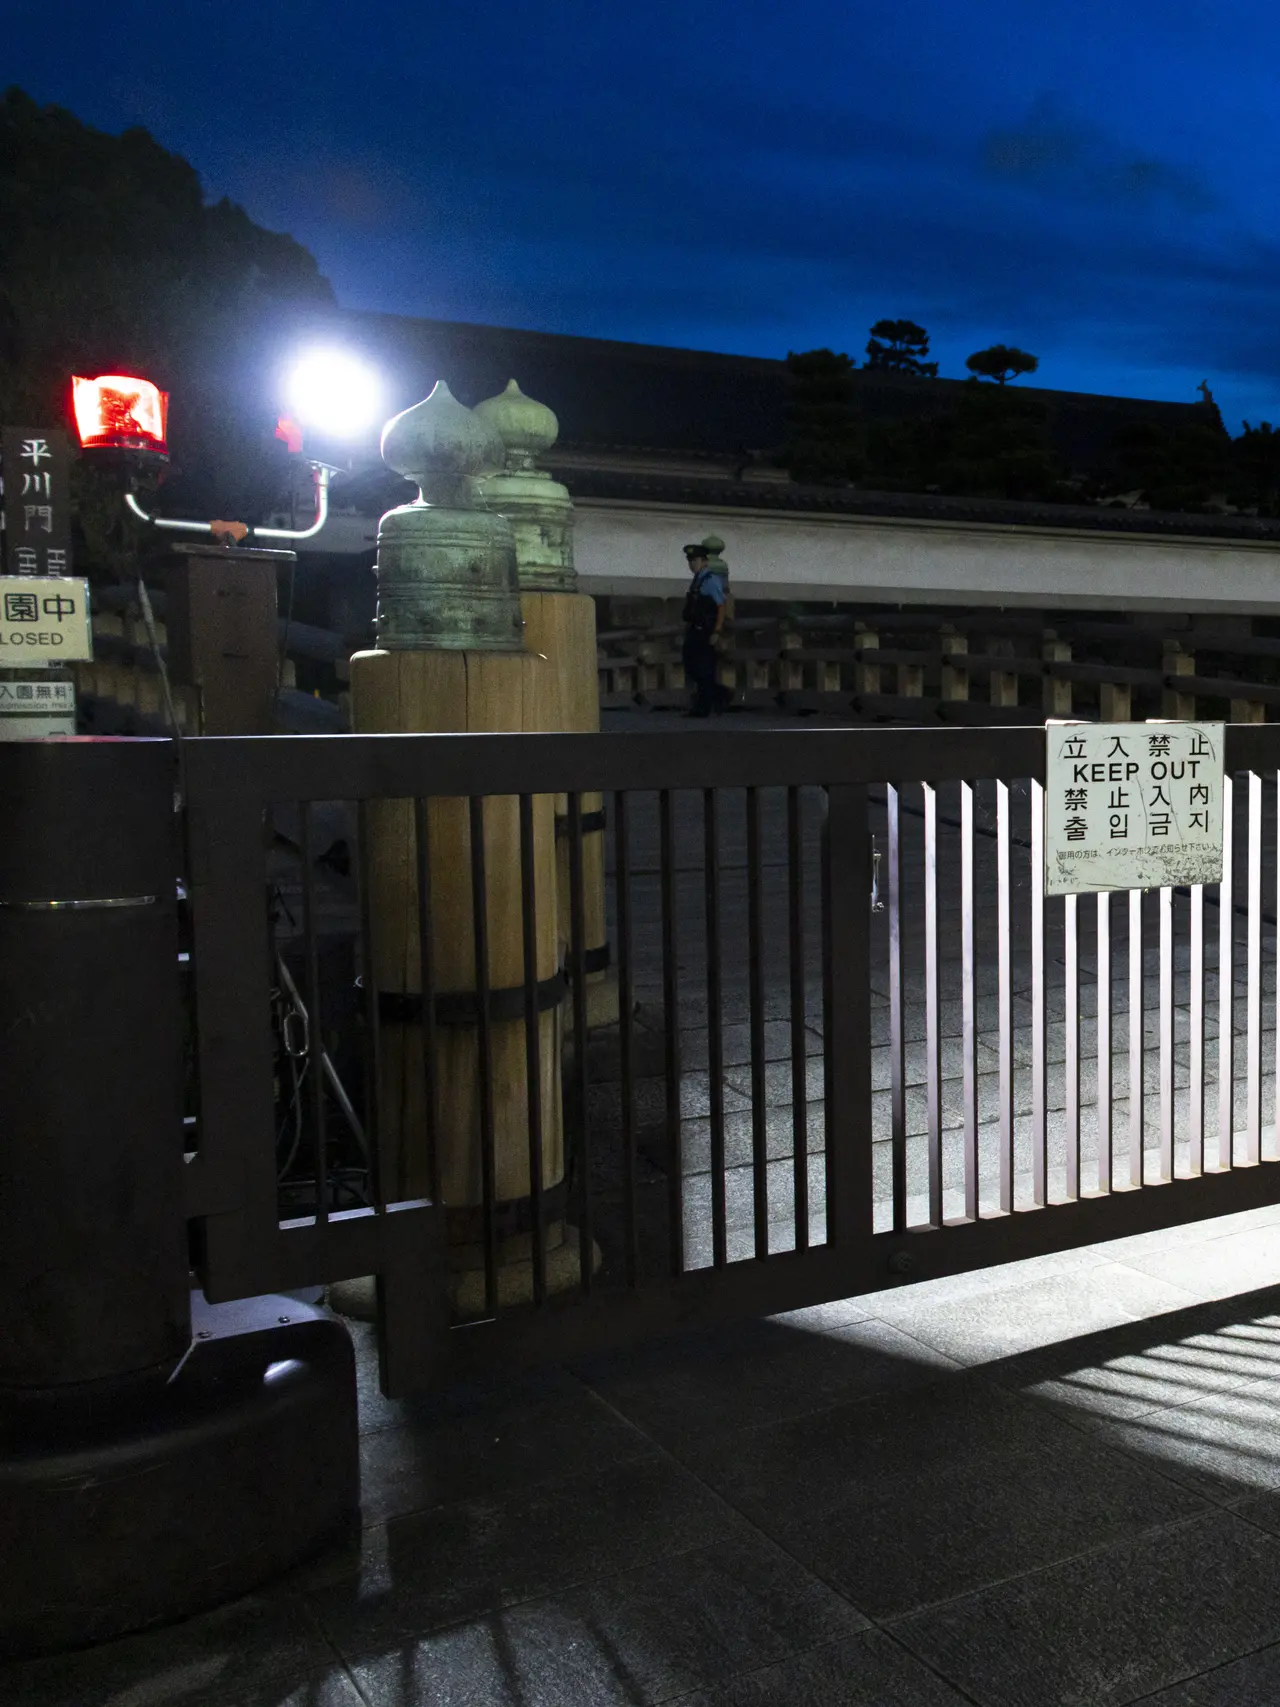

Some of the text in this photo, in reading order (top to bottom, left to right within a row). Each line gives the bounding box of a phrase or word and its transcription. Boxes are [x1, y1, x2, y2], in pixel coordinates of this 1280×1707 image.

[20, 439, 52, 534] 平川門
[0, 594, 75, 622] 園中
[0, 685, 66, 699] 入園無料
[1063, 735, 1210, 759] 立入禁止
[1073, 760, 1201, 783] KEEP OUT
[1064, 784, 1209, 811] 禁止入内
[1063, 810, 1209, 841] 출입금지
